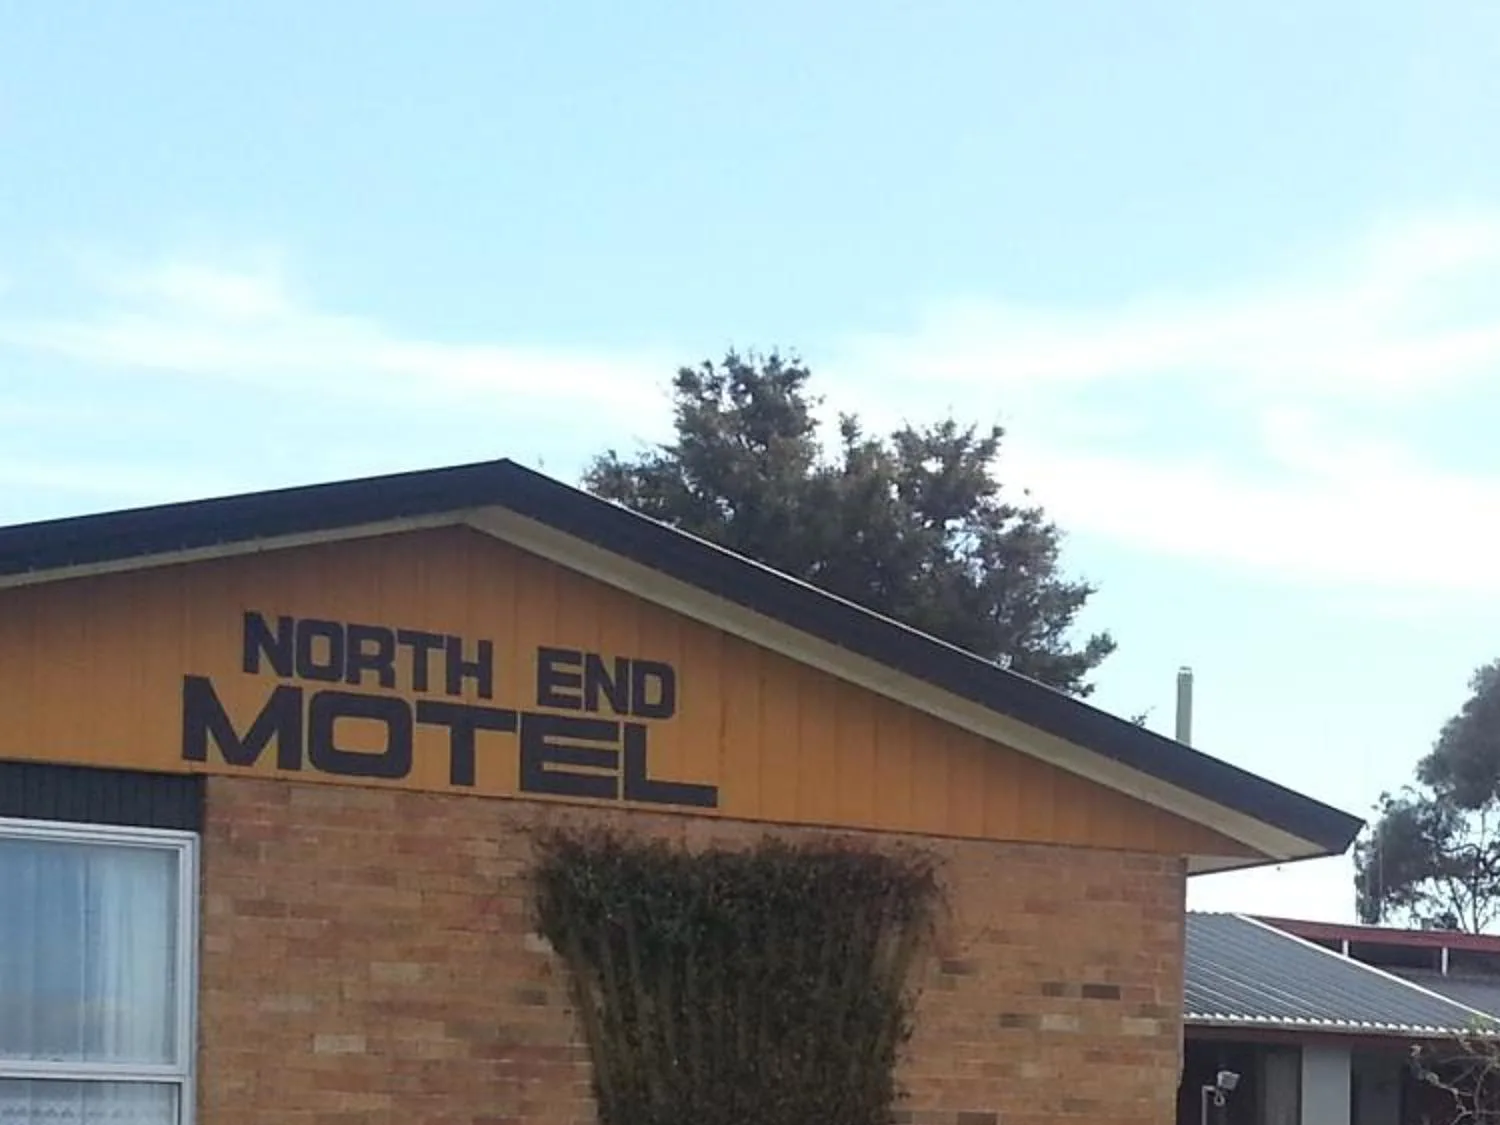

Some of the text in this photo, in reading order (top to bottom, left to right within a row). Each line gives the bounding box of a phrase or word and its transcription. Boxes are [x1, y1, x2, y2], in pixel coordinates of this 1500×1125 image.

[243, 610, 675, 719] NORTH END
[182, 674, 718, 808] MOTEL
